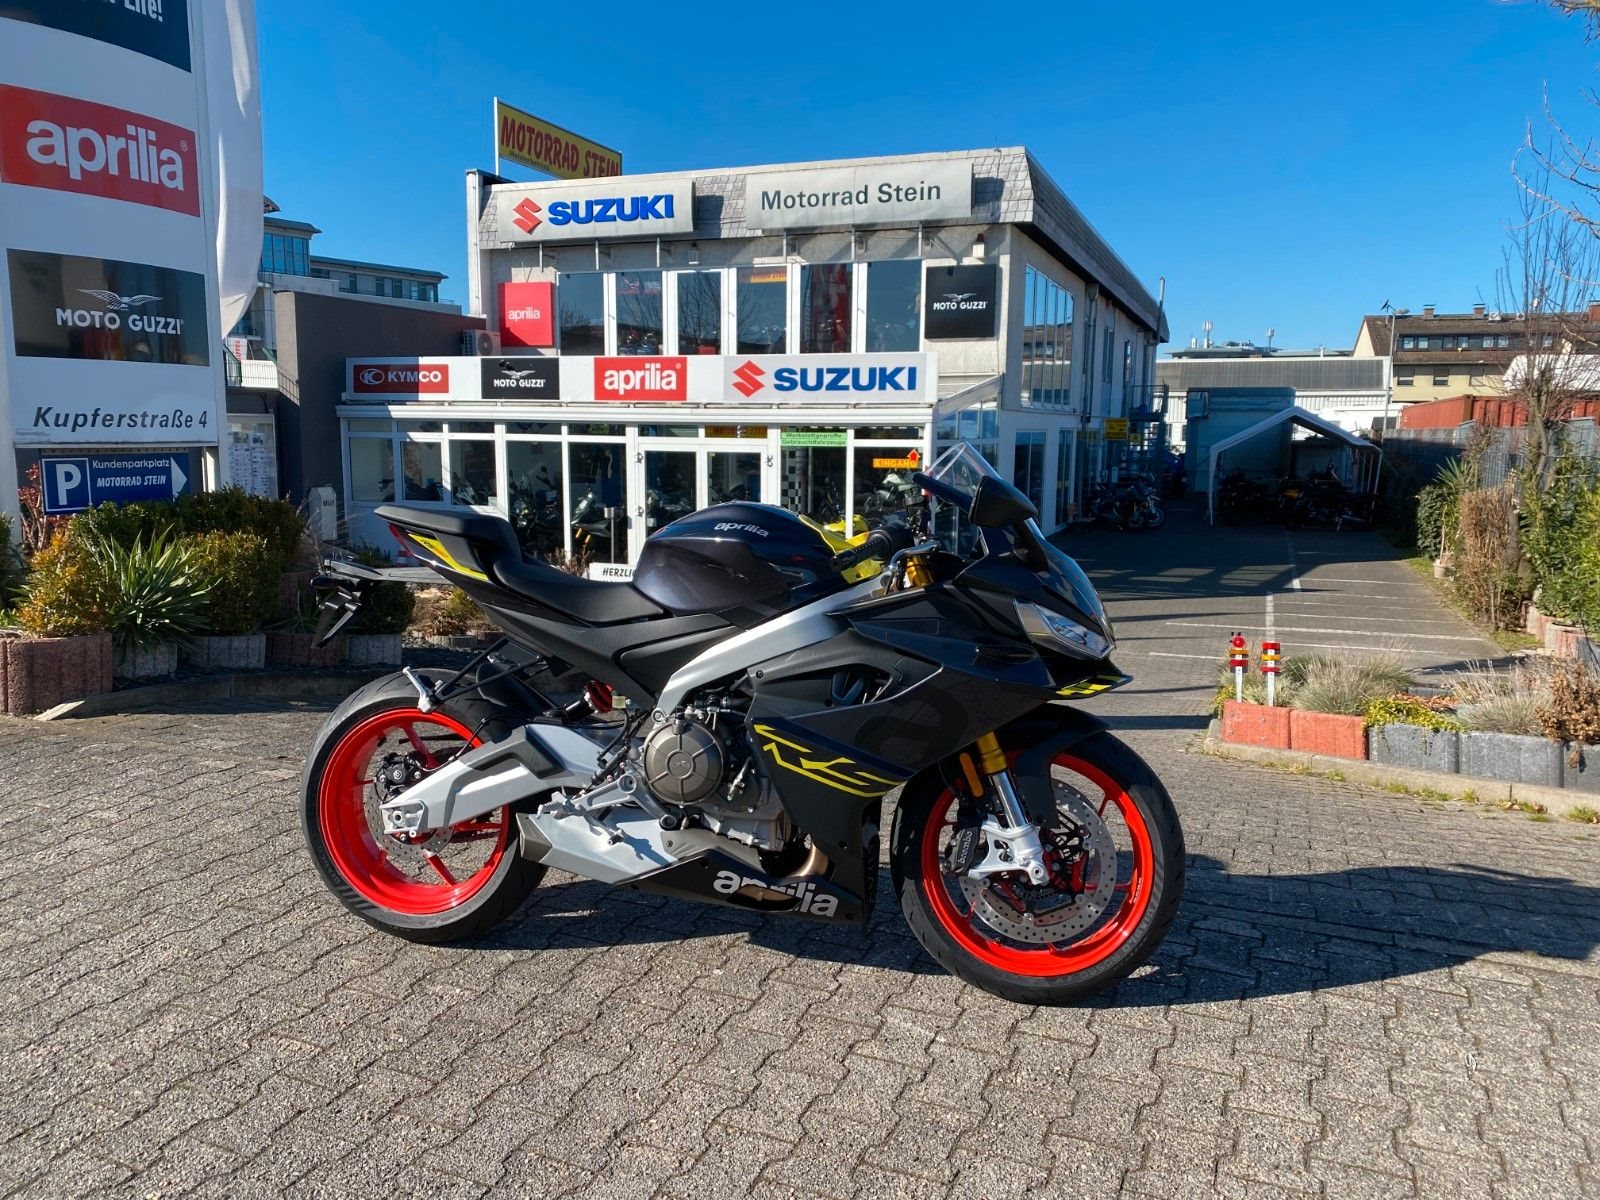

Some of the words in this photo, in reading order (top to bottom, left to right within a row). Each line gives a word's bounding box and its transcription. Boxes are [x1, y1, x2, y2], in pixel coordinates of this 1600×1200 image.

[124, 0, 163, 22] fe!
[26, 120, 185, 191] aprilia
[501, 115, 580, 172] MOTORRAD
[583, 150, 619, 178] STEIN
[761, 185, 869, 210] Motorrad
[877, 181, 941, 204] Stein
[548, 194, 674, 226] SUZUKI
[508, 307, 541, 321] aprilia
[933, 302, 957, 310] MOTO
[960, 301, 986, 310] GUZZI
[56, 308, 121, 329] MOTO
[128, 314, 181, 335] GUZZI
[387, 370, 442, 383] KYMCO
[493, 379, 516, 387] MOTO
[518, 379, 543, 387] GUZZI
[603, 363, 677, 395] aprilia
[773, 366, 917, 391] SUZUKI
[33, 406, 193, 432] Kupferstraße
[198, 411, 208, 428] 4
[92, 459, 170, 469] Kundenparkplatz
[56, 463, 81, 506] P
[96, 477, 142, 488] MOTORRAD
[144, 475, 167, 486] STEIN
[714, 522, 769, 537] aprilia
[602, 567, 632, 577] HERZLI
[957, 831, 973, 864] brembo
